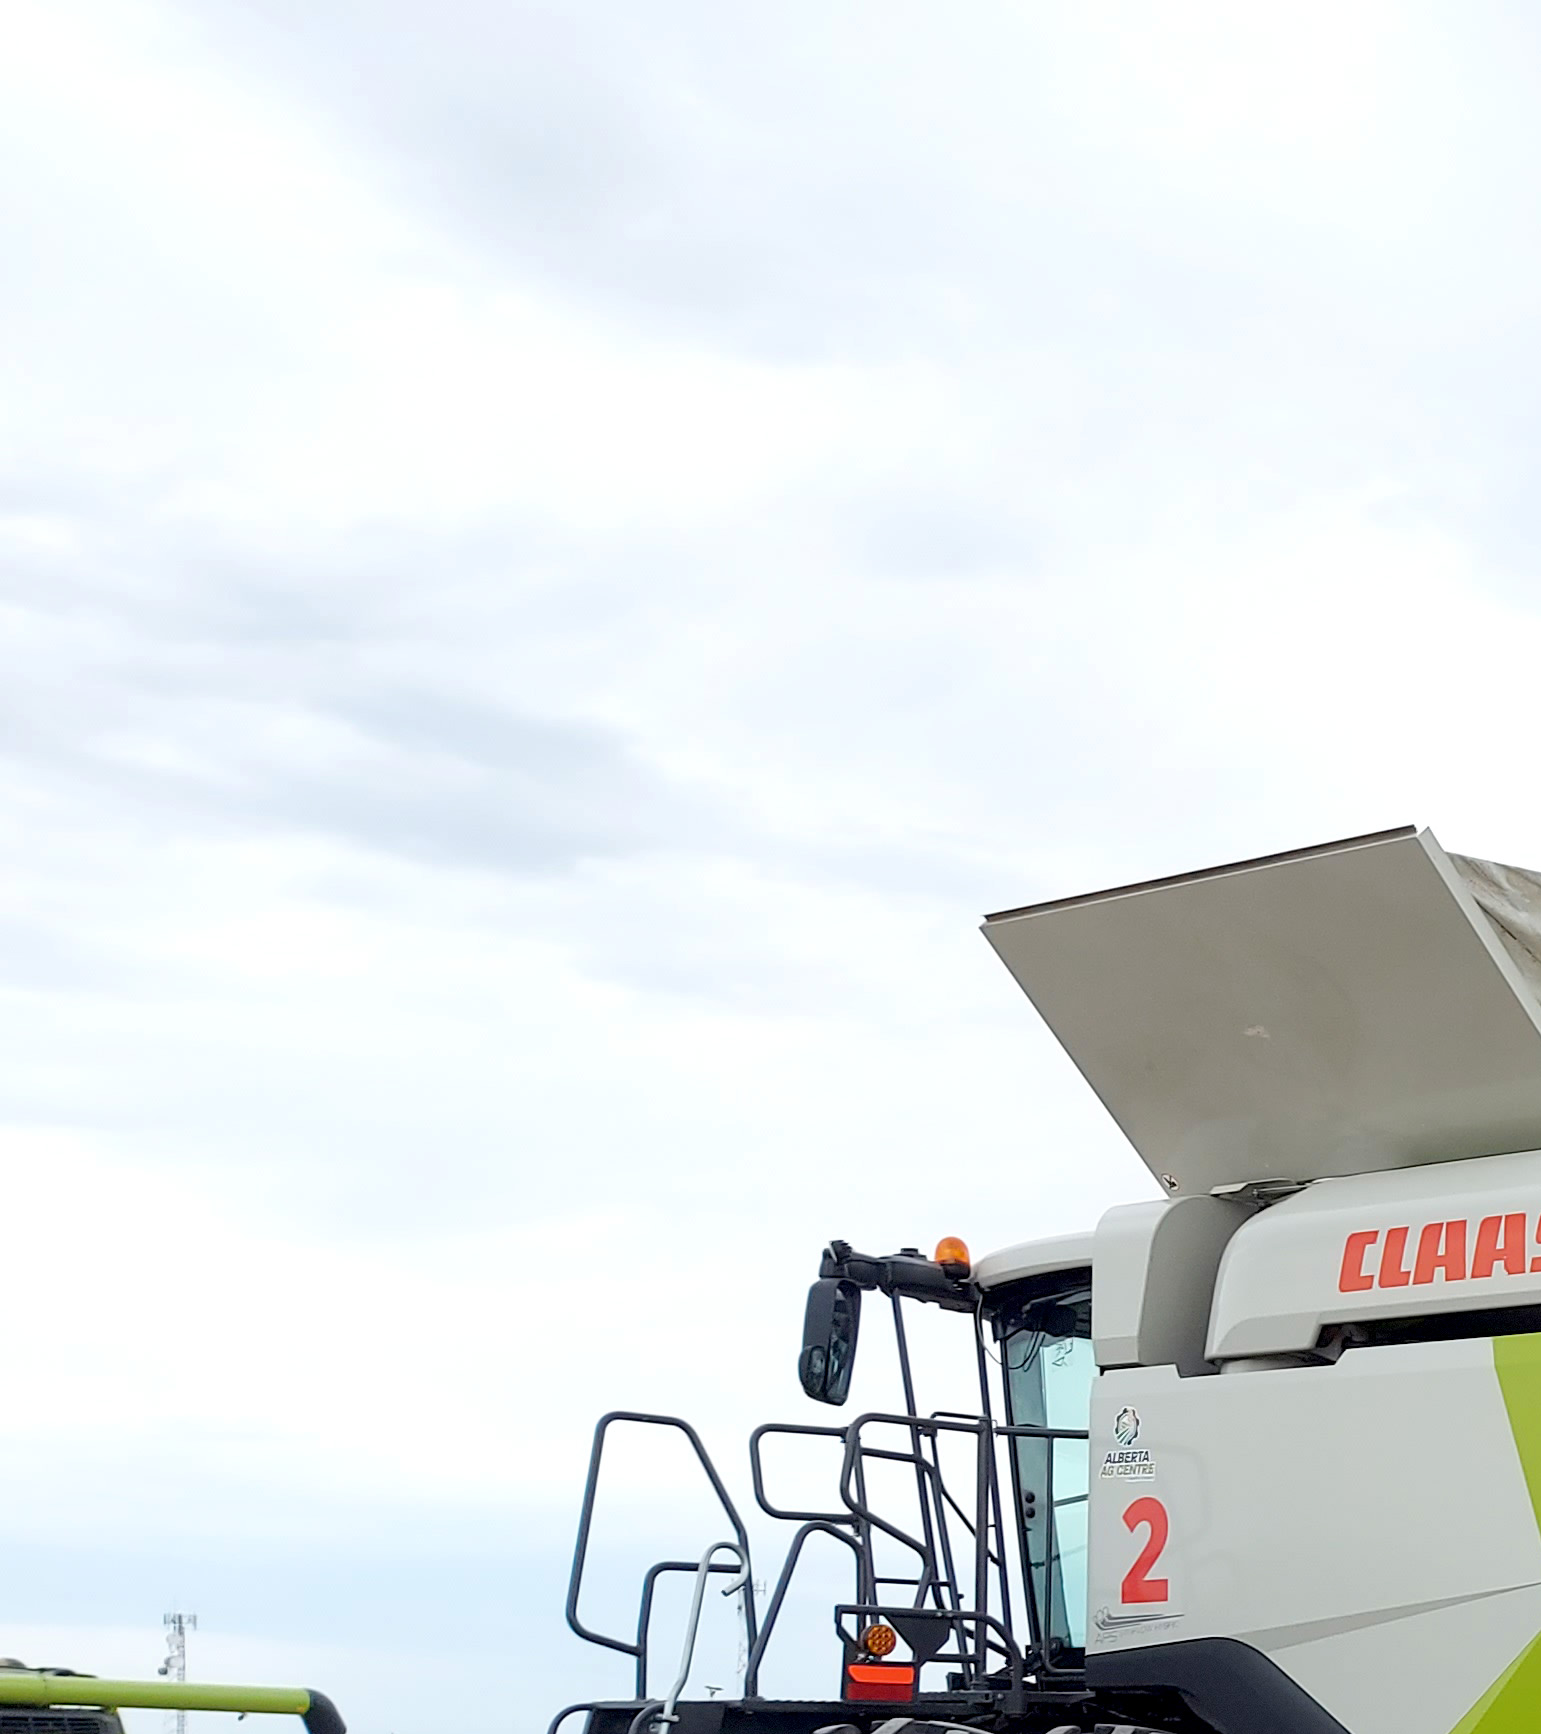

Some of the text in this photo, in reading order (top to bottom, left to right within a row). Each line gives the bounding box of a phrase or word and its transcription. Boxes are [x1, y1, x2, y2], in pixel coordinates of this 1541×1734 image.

[1104, 1450, 1150, 1464] ALBERTA
[1100, 1463, 1155, 1477] AG CENTRE
[1121, 1496, 1169, 1604] 2
